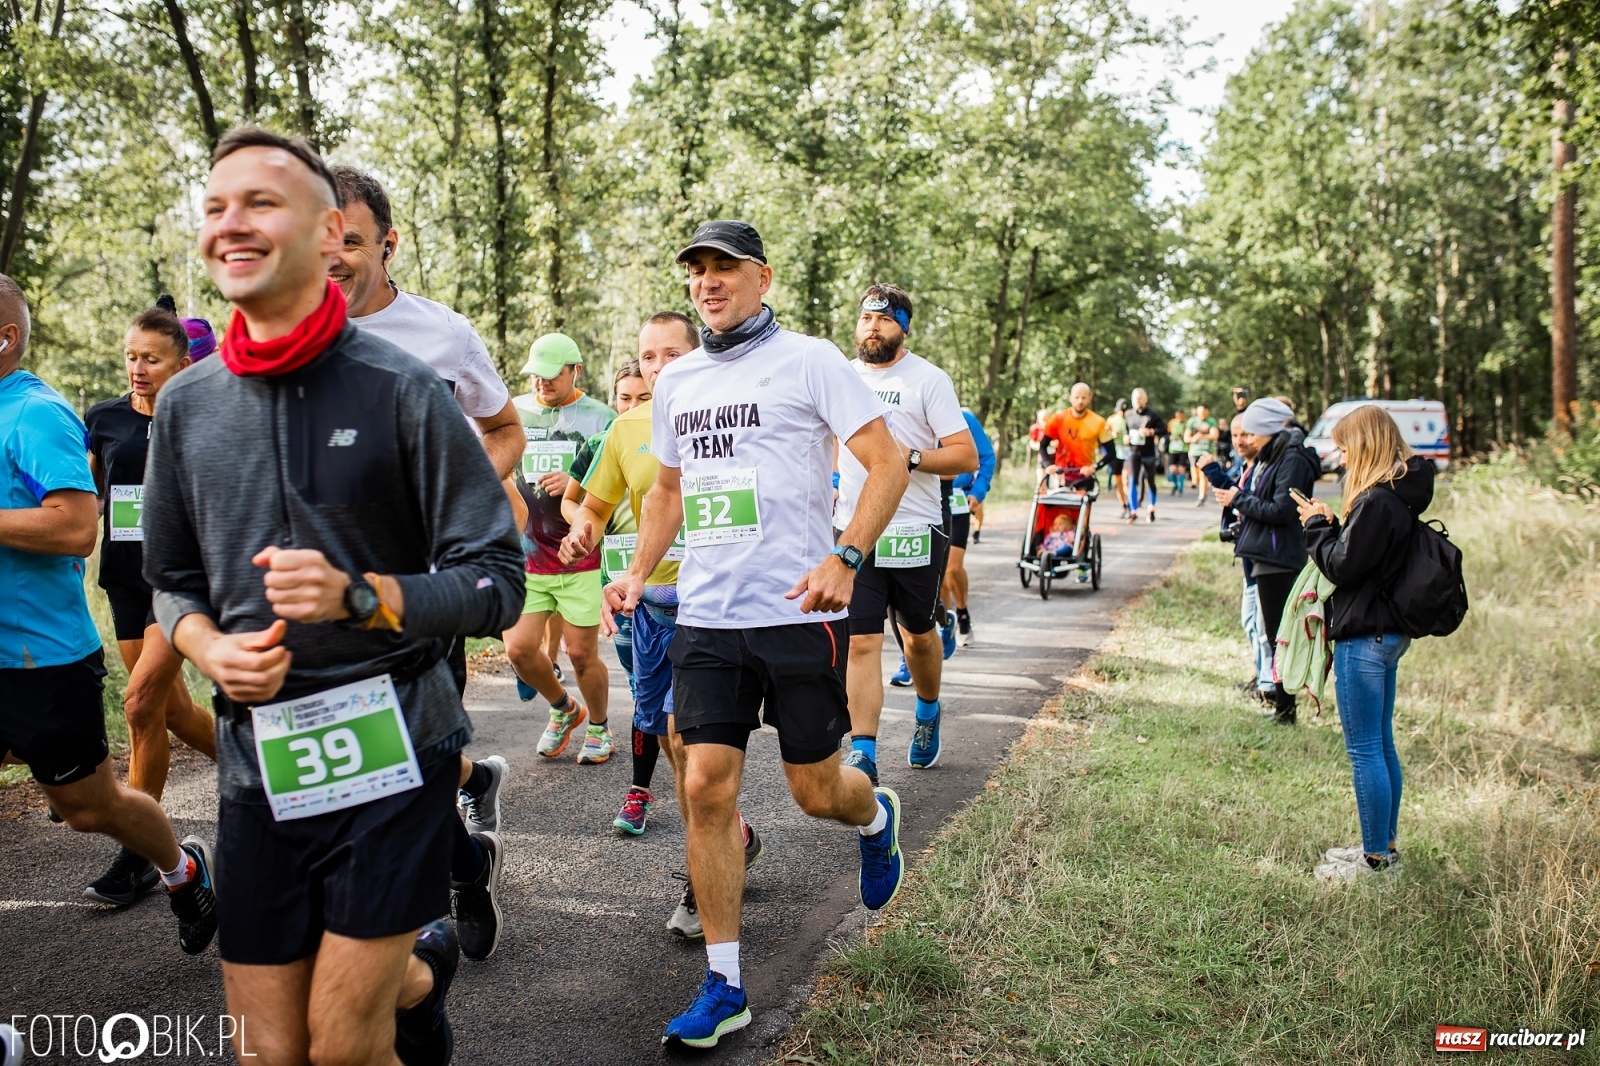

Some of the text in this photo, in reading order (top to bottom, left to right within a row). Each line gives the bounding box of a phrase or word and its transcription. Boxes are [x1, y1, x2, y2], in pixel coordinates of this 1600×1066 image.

[715, 403, 761, 429] HUTA
[531, 454, 563, 472] 103
[696, 495, 733, 527] 32
[619, 549, 636, 569] 1
[889, 537, 922, 557] 149
[281, 706, 293, 731] V
[288, 727, 364, 785] 39
